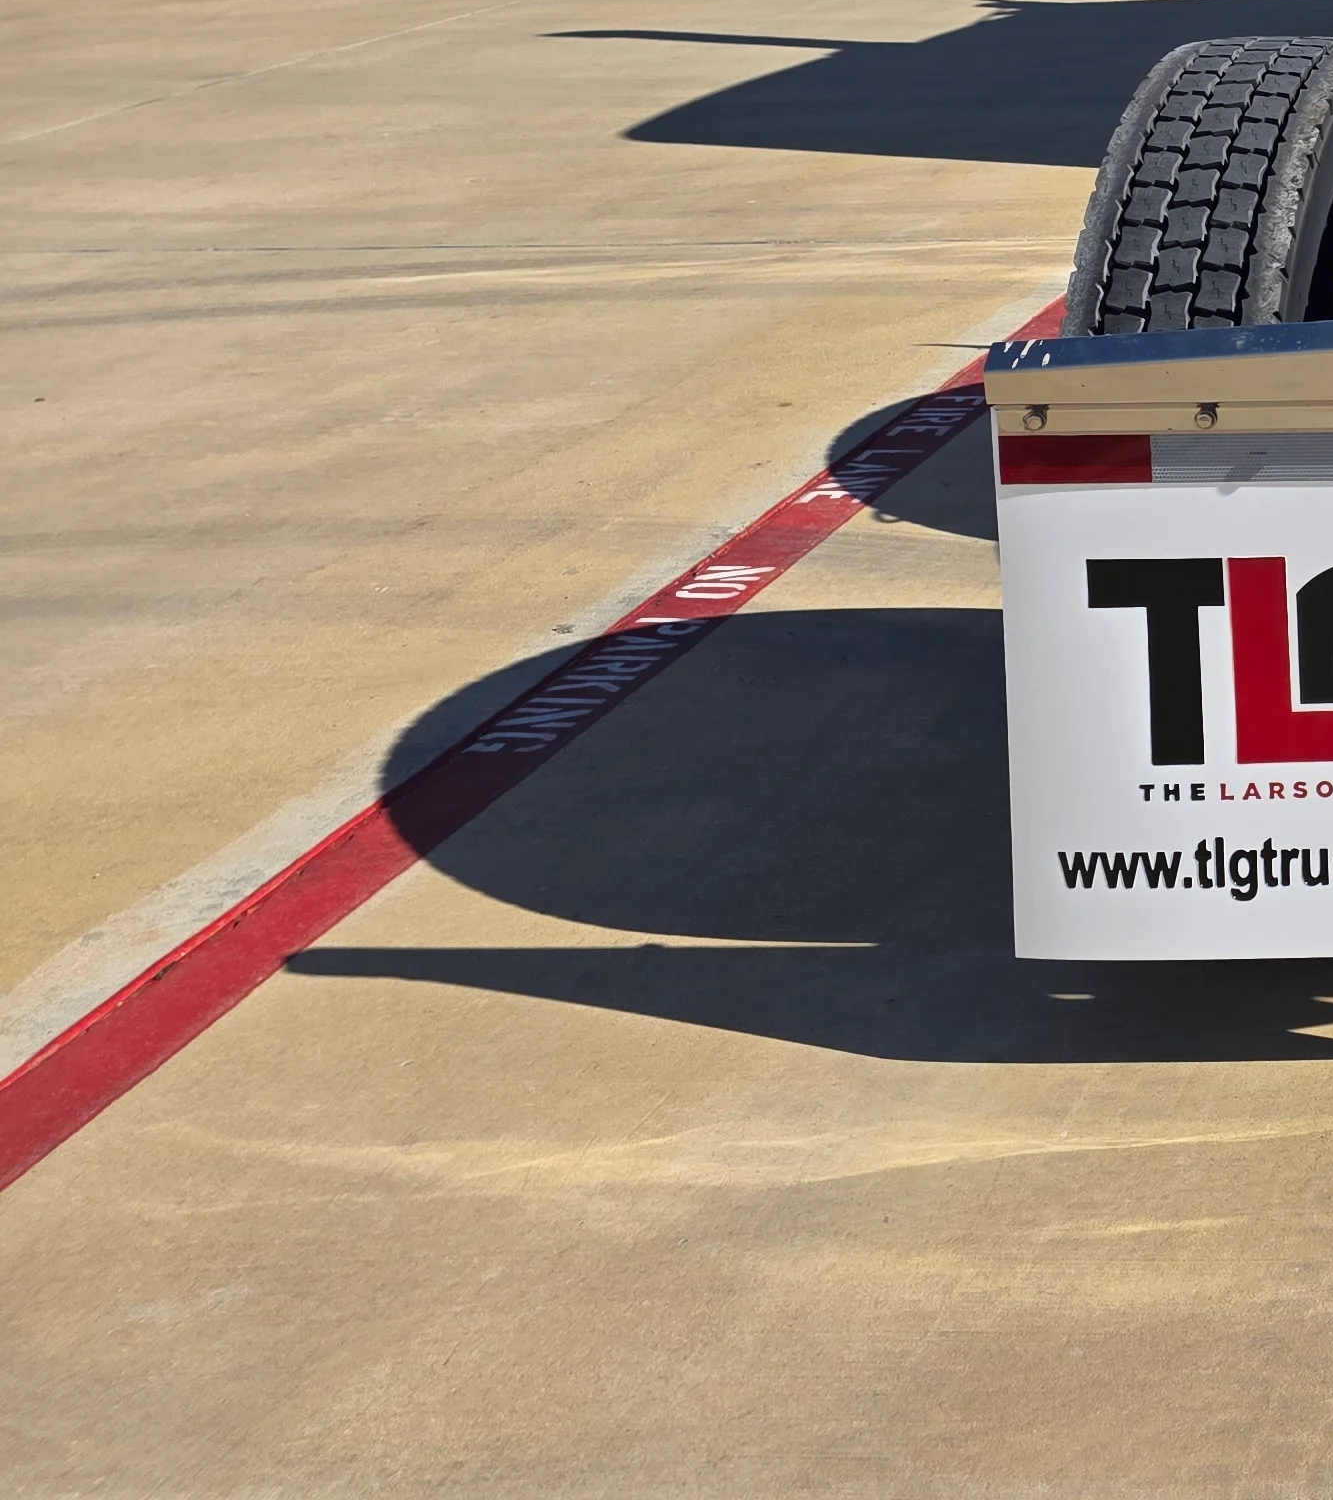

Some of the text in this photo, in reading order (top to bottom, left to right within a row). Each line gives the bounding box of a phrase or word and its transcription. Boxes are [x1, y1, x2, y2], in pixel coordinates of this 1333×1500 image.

[460, 395, 986, 753] FIRE LANE NO PARKING
[1139, 784, 1205, 801] THE
